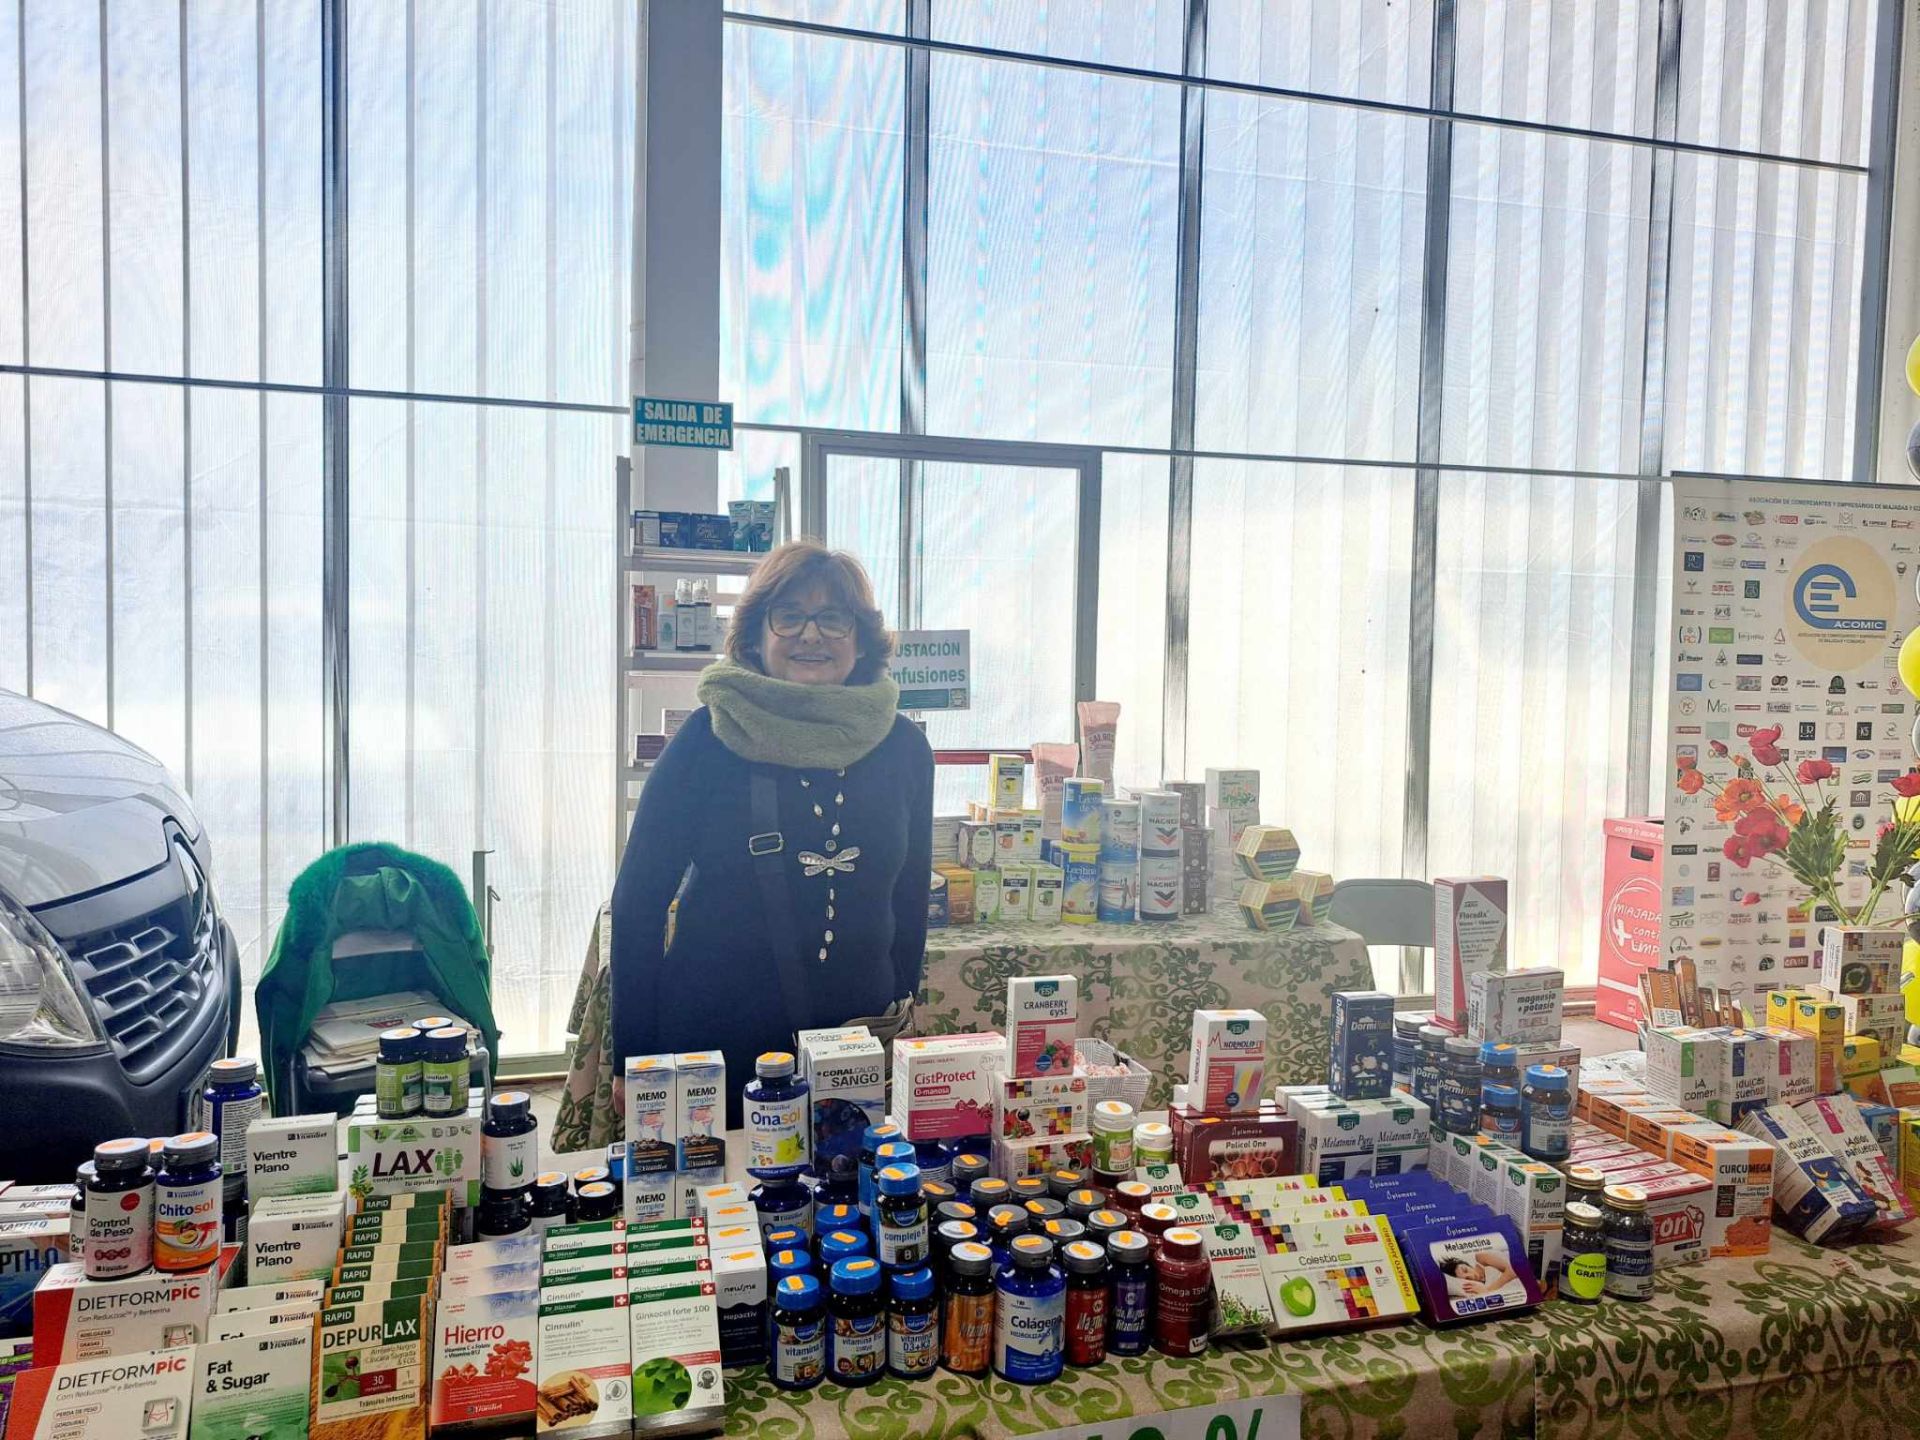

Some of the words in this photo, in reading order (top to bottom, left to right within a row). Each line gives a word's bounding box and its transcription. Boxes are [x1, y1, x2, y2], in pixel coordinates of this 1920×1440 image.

[644, 403, 697, 424] SALIDA
[702, 405, 723, 425] DE
[637, 423, 730, 448] EMERGENCIA
[1833, 620, 1884, 630] ACOMIC
[895, 640, 961, 658] USTACIÓN
[1613, 902, 1662, 923] MIAJADA
[1632, 926, 1661, 938] conti
[1023, 1000, 1068, 1010] CRANBERRY
[1050, 1007, 1068, 1017] cyst
[914, 1070, 976, 1085] CistProtect
[1416, 1066, 1438, 1080] Dorm
[832, 1072, 879, 1088] SANGO
[636, 1090, 667, 1102] MEMO
[687, 1086, 716, 1098] MEMO
[915, 1086, 950, 1096] D-manosa
[636, 1101, 666, 1110] complex
[686, 1096, 716, 1106] complex
[751, 1109, 801, 1126] Onasol
[1225, 1140, 1251, 1149] Policol
[1252, 1139, 1267, 1148] One
[253, 1149, 297, 1163] Vientre
[254, 1162, 290, 1175] Plano
[373, 1148, 435, 1178] LAX
[1719, 1163, 1772, 1175] CURCUMEGA
[366, 1199, 389, 1209] RAPID
[635, 1192, 666, 1205] MEMO
[158, 1198, 214, 1216] Chitosol
[635, 1202, 665, 1212] complex
[90, 1216, 130, 1228] Control
[356, 1216, 380, 1228] RAPID
[90, 1227, 101, 1238] de
[104, 1226, 134, 1239] Peso
[354, 1232, 379, 1243] RAPID
[884, 1231, 921, 1243] complejo
[255, 1240, 301, 1254] Vientre
[1444, 1238, 1491, 1251] Melanoctina
[255, 1254, 293, 1268] Plano
[346, 1250, 371, 1261] RAPID
[342, 1269, 369, 1280] RAPID
[334, 1289, 361, 1301] RAPID
[1160, 1283, 1191, 1297] Omega
[324, 1311, 352, 1323] RAPID
[672, 1306, 692, 1317] forte
[694, 1304, 710, 1314] 100
[1011, 1315, 1063, 1332] Colágeno
[323, 1319, 417, 1349] DEPURLAX
[444, 1324, 504, 1346] Hierro
[207, 1360, 232, 1376] Fat
[206, 1379, 217, 1394] &
[222, 1372, 270, 1390] Sugar
